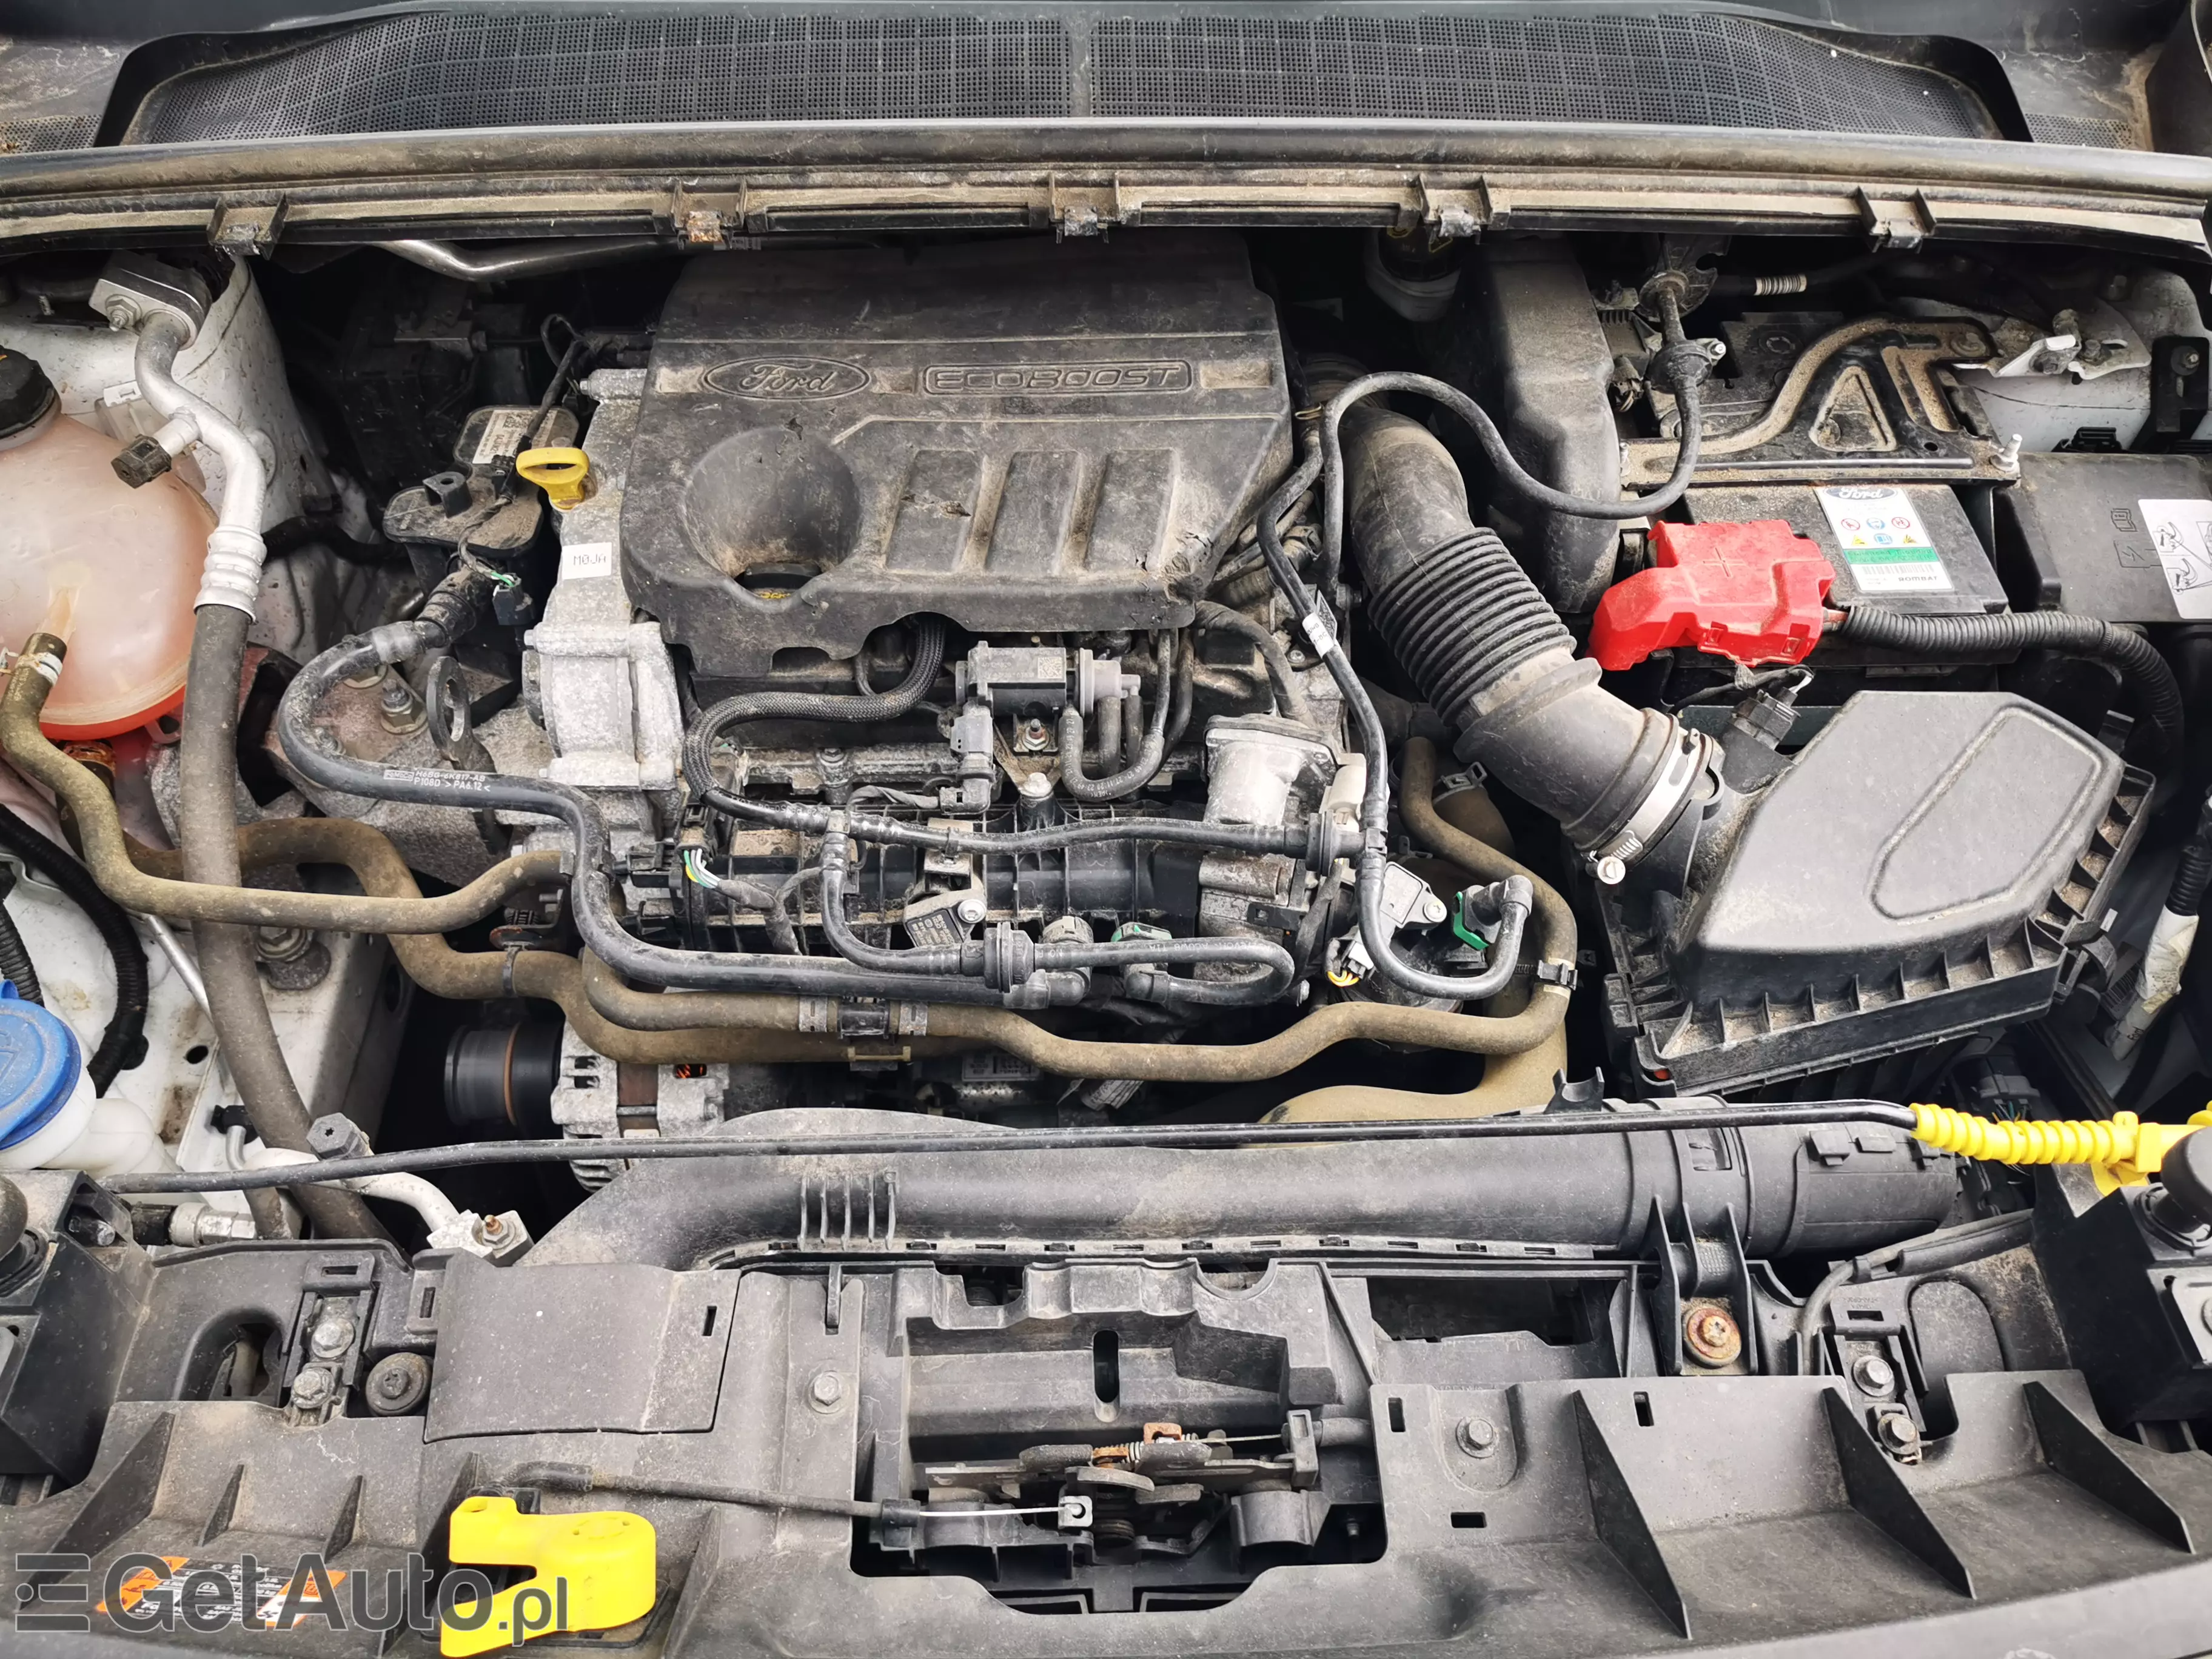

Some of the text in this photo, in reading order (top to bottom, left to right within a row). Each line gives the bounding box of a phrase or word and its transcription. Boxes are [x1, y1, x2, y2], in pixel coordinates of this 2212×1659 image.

[739, 363, 838, 392] Ford
[934, 366, 1181, 390] ECOBOOST
[1838, 486, 1883, 499] Ford
